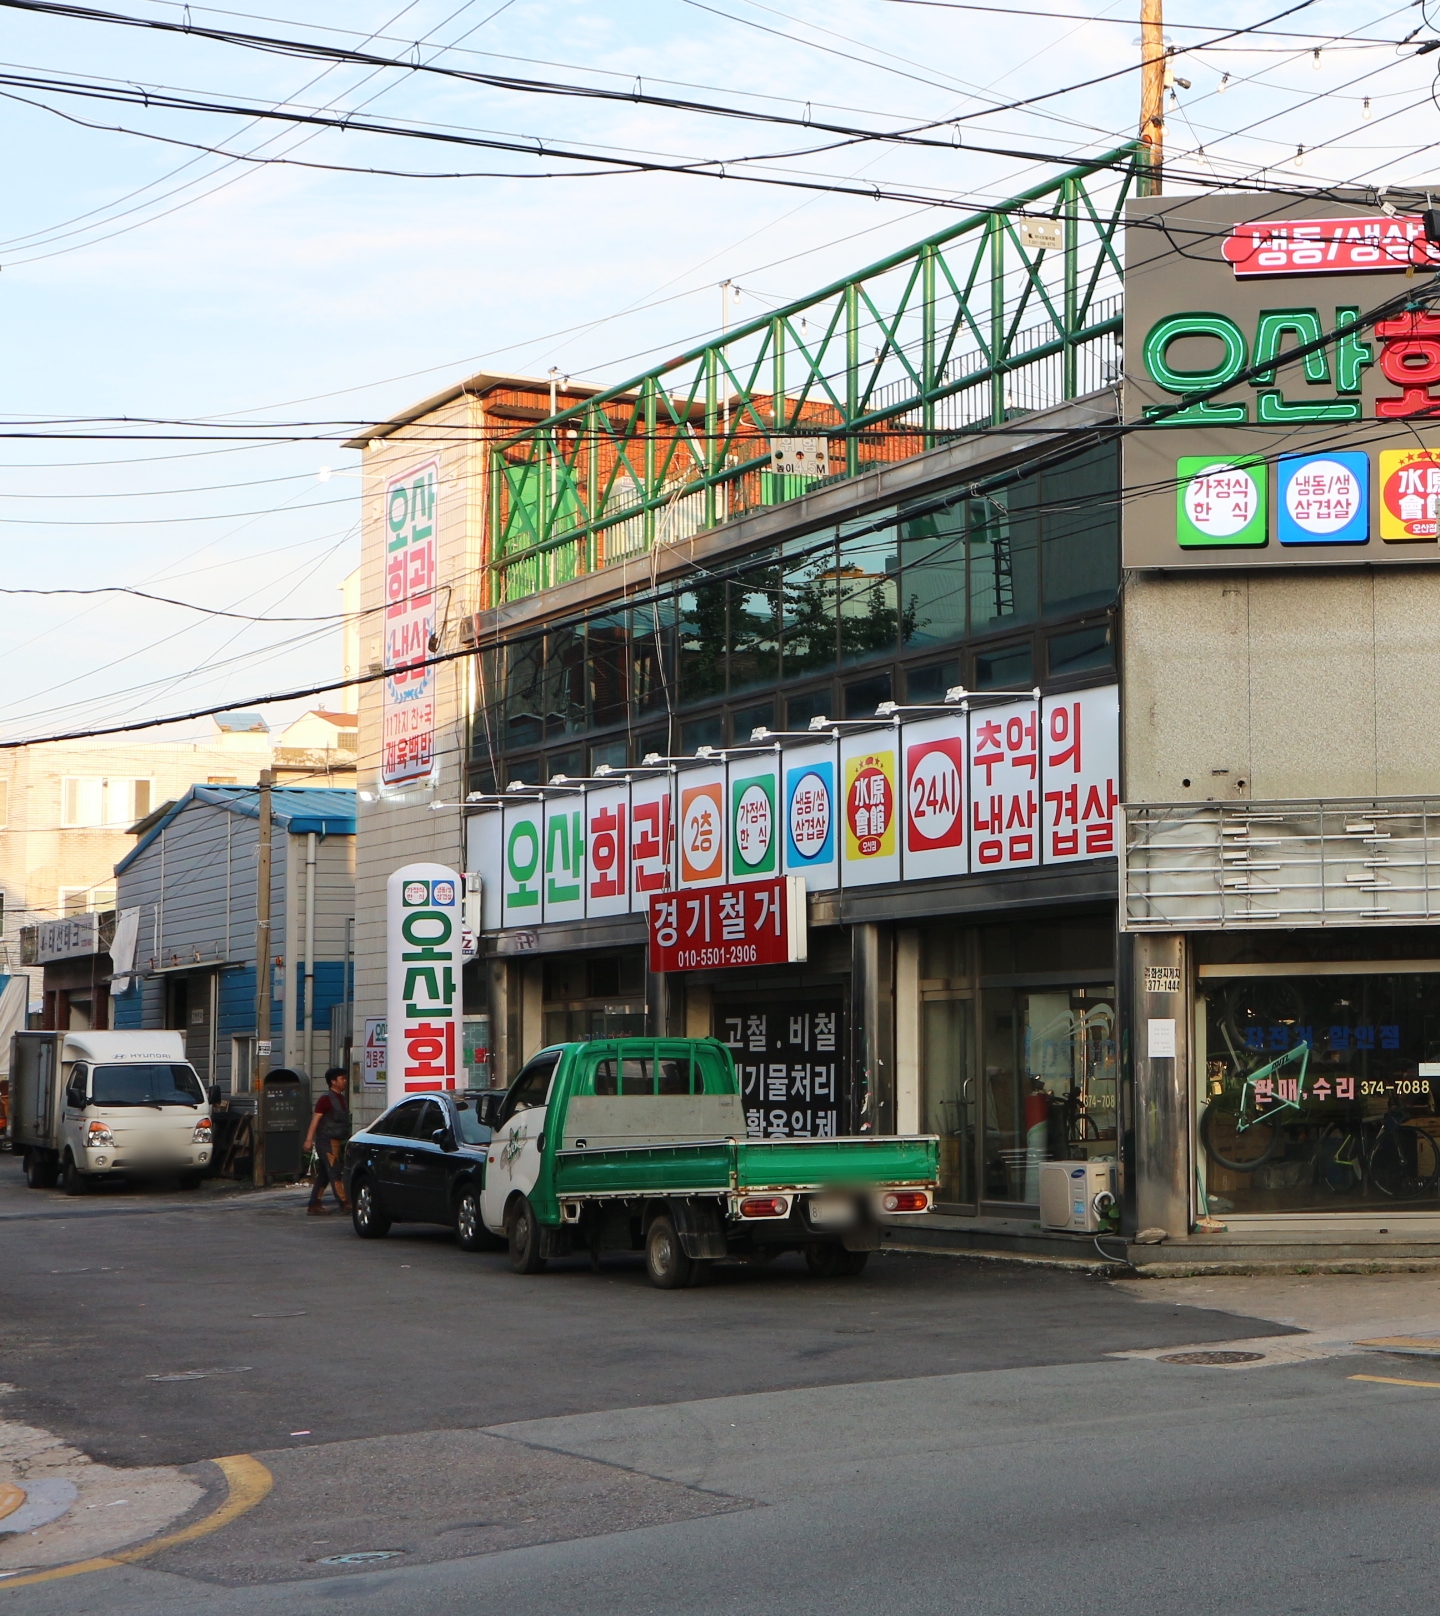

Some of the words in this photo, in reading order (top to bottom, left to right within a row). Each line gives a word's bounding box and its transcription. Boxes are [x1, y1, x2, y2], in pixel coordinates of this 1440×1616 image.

[1193, 478, 1249, 499] 가정식
[1295, 474, 1351, 497] 냉동/생
[388, 471, 435, 553] 오산
[1295, 499, 1352, 520] 삼겹살
[1412, 523, 1437, 534] 오산점
[387, 540, 435, 619] 회관
[385, 709, 408, 738] 11가지
[385, 732, 431, 775] 제육백반
[973, 702, 1081, 787] 추억의
[795, 787, 826, 817] 냉동/생
[854, 773, 886, 807] 水原
[914, 768, 957, 818] 24시
[739, 797, 768, 824] 가정식
[973, 779, 1119, 865] 냉삼겹살
[691, 809, 713, 853] 2층
[795, 814, 826, 843] 삼겹살
[507, 793, 675, 909] 오산회관
[654, 886, 782, 948] 경기철거
[678, 944, 757, 968] 010-5501-2906
[402, 910, 457, 1092] 오산회
[724, 1015, 767, 1052] 고철
[789, 1012, 836, 1051] 비철
[1329, 1024, 1400, 1049] 할인점
[1360, 1079, 1430, 1095] 374-7088
